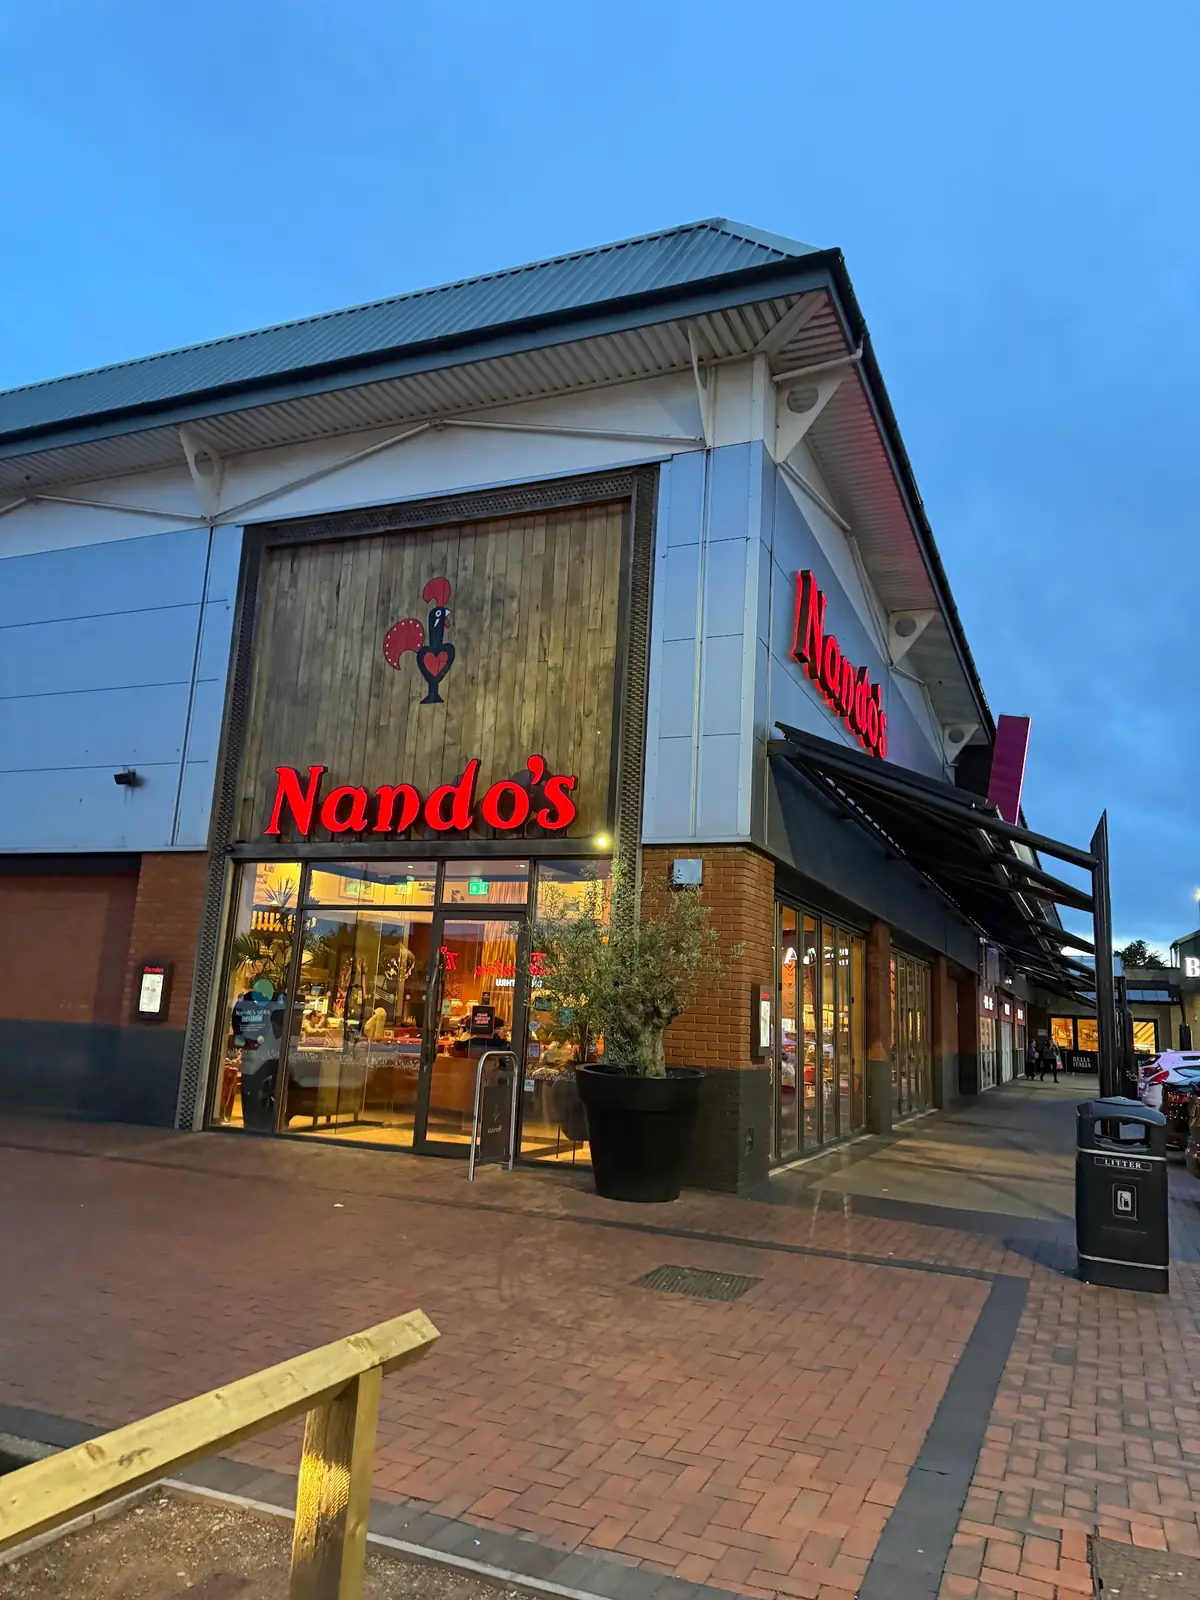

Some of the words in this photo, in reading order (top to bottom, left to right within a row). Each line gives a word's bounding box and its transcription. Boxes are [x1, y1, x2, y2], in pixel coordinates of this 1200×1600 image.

[790, 569, 888, 759] Nando's
[264, 754, 577, 836] Nando's
[1104, 1159, 1142, 1169] LITTER
